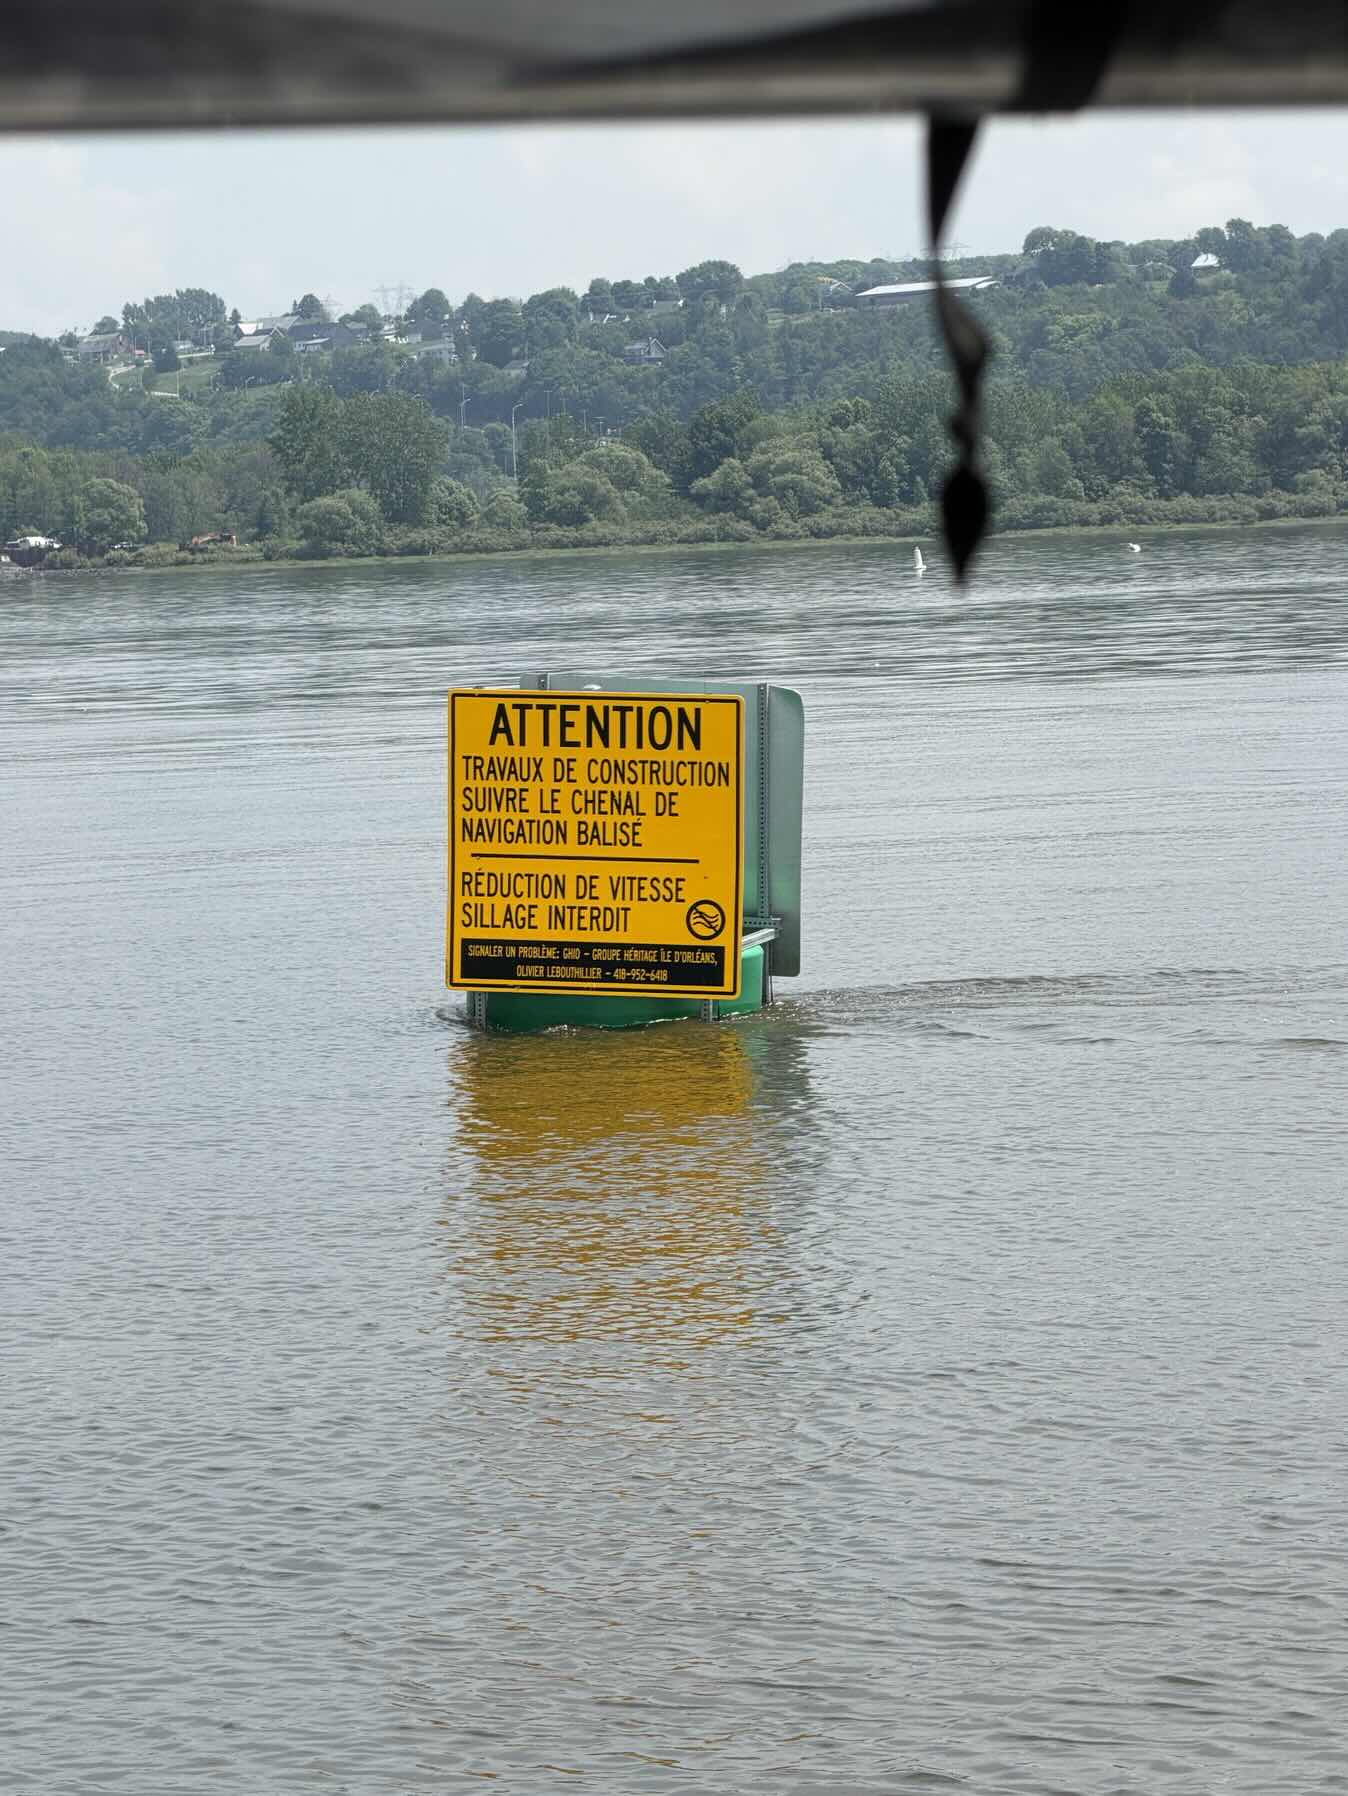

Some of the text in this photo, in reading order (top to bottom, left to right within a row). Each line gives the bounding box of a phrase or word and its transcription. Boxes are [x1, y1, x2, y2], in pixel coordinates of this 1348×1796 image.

[488, 703, 701, 751] ATTENTION
[462, 755, 730, 787] TRAVAUX DE CONSTRUCTION
[462, 787, 679, 817] SUIVRE LE CHENAL DE
[462, 818, 642, 847] NAVIGATION BALISÉ
[461, 868, 686, 903] RÉDUCTION DE VITESSE
[461, 903, 631, 932] SILLAGE INTERDIT
[468, 944, 503, 957] SIGNALER
[505, 946, 516, 958] UN
[519, 944, 560, 959] PROBLÈME:
[592, 948, 621, 961] GROUPE
[624, 947, 659, 962] HÉRITAGE
[675, 949, 718, 966] D'ORLÉANS,
[516, 964, 545, 977] OLIVIER
[547, 966, 602, 979] LEBOUTHILLIER
[613, 968, 668, 981] 418-952-6418
